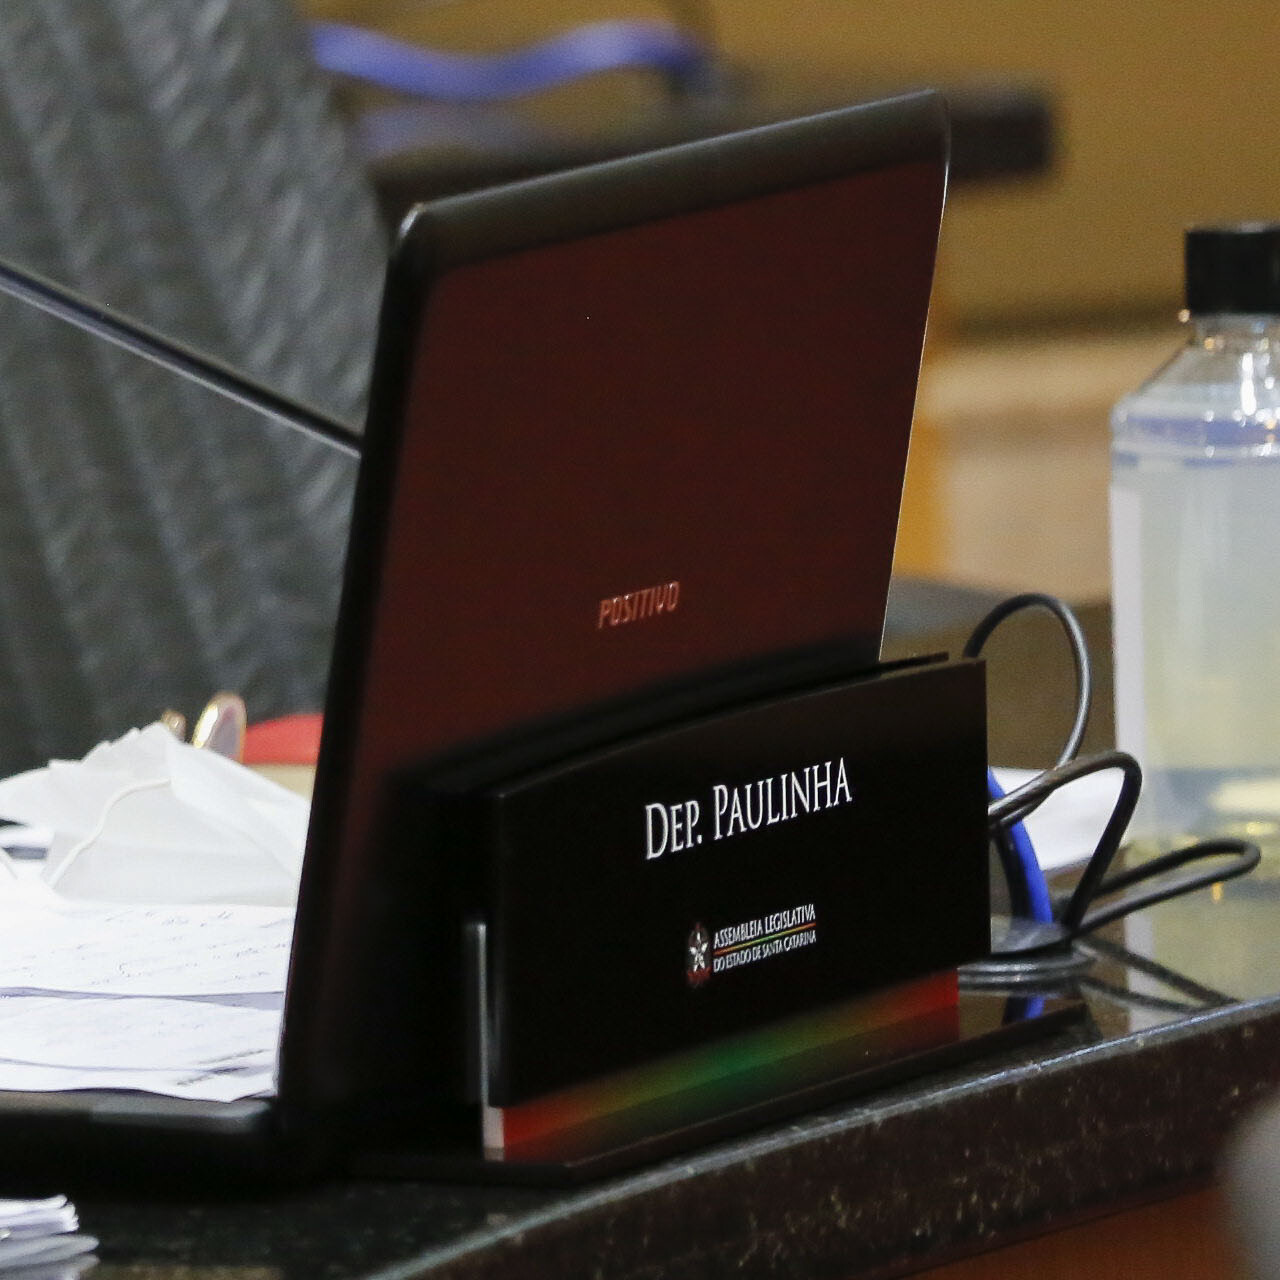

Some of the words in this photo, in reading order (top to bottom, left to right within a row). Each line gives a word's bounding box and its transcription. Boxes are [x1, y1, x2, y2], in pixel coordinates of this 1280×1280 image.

[598, 581, 680, 630] POSITIVO
[645, 800, 703, 860] DEP.
[712, 757, 853, 841] PAULINHA
[714, 919, 763, 949] ASSEMBLEIA
[765, 904, 815, 933] LEGISLATIVA
[713, 957, 725, 973] DO
[726, 949, 751, 969] ESTADO
[752, 945, 761, 961] DE
[762, 940, 782, 958] SANTA
[783, 930, 816, 951] CATARINA
